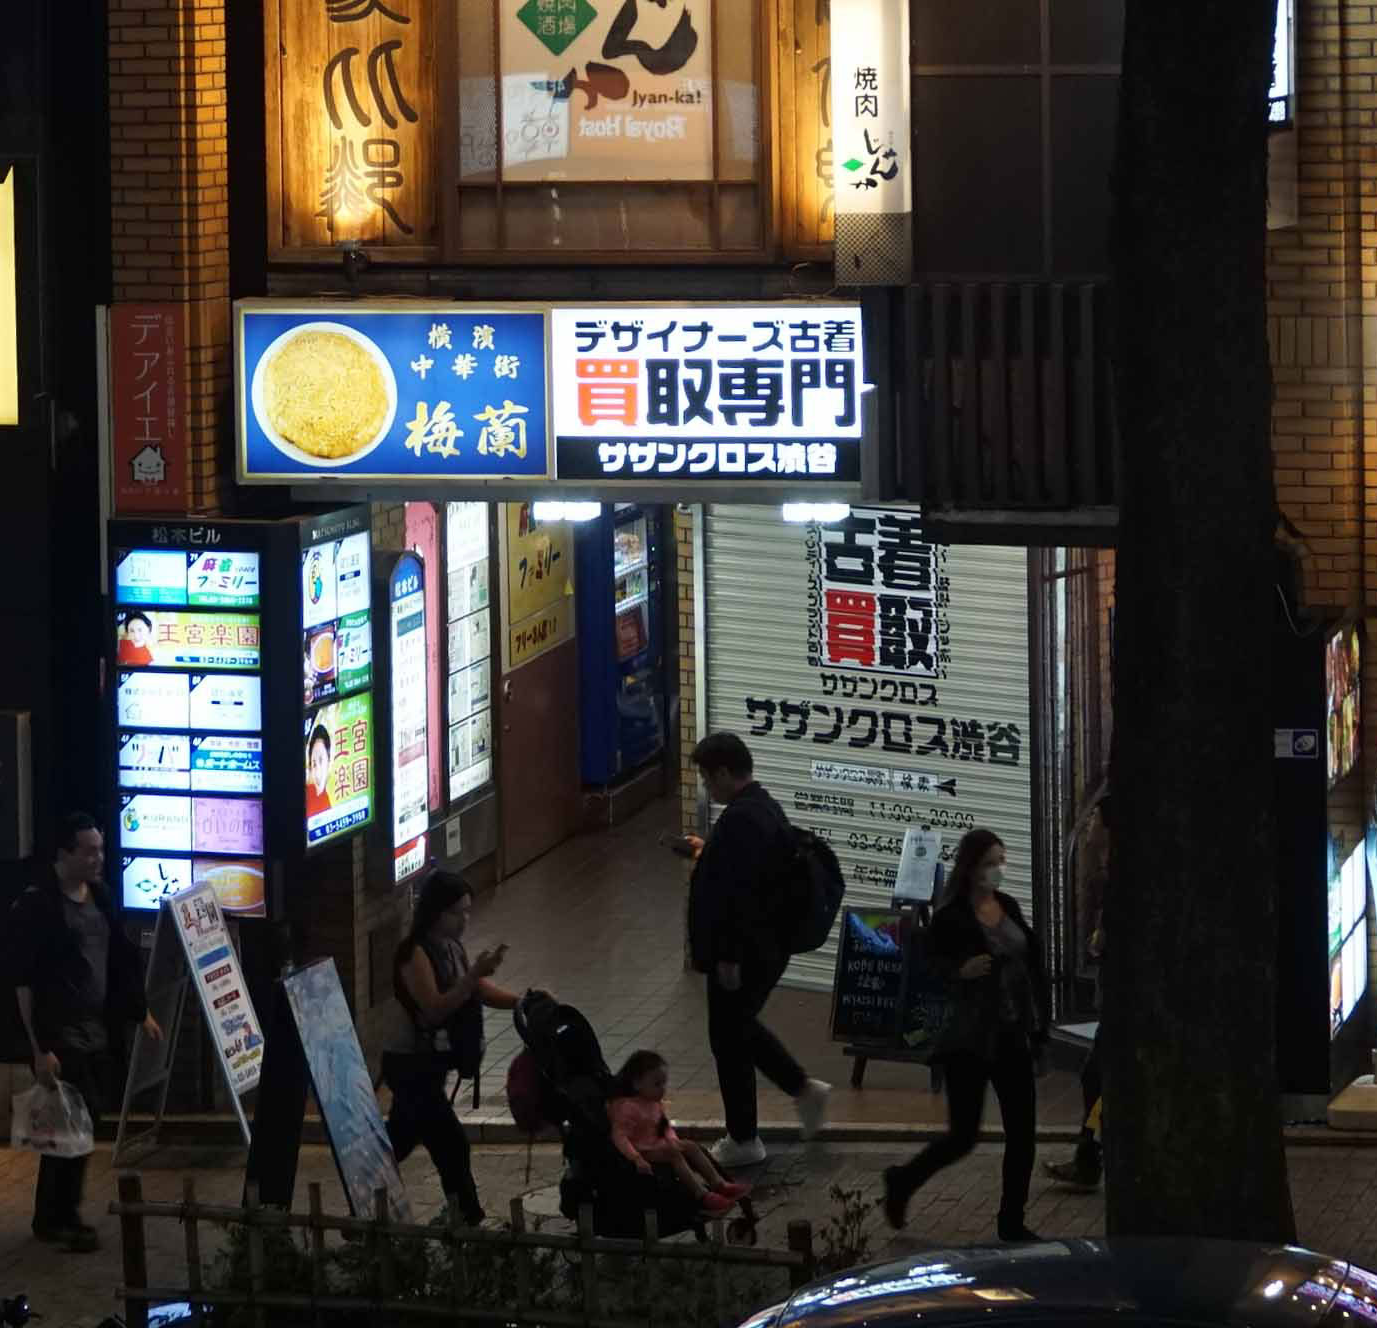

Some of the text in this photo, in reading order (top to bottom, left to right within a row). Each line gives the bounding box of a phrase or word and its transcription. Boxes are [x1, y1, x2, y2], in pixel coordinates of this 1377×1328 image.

[632, 89, 703, 108] Jyan-ka!
[853, 66, 879, 119] 焼肉
[574, 318, 857, 354] デザイナーズ古着
[129, 313, 163, 441] デアイエ
[409, 353, 521, 382] 中華街
[575, 357, 857, 429] 買取専門
[403, 399, 530, 460] 梅蘭
[598, 442, 838, 476] サザンクロス渋谷
[151, 526, 222, 545] 松本ビル
[824, 588, 935, 671] 買取
[745, 697, 1022, 767] サザンクロス渋谷
